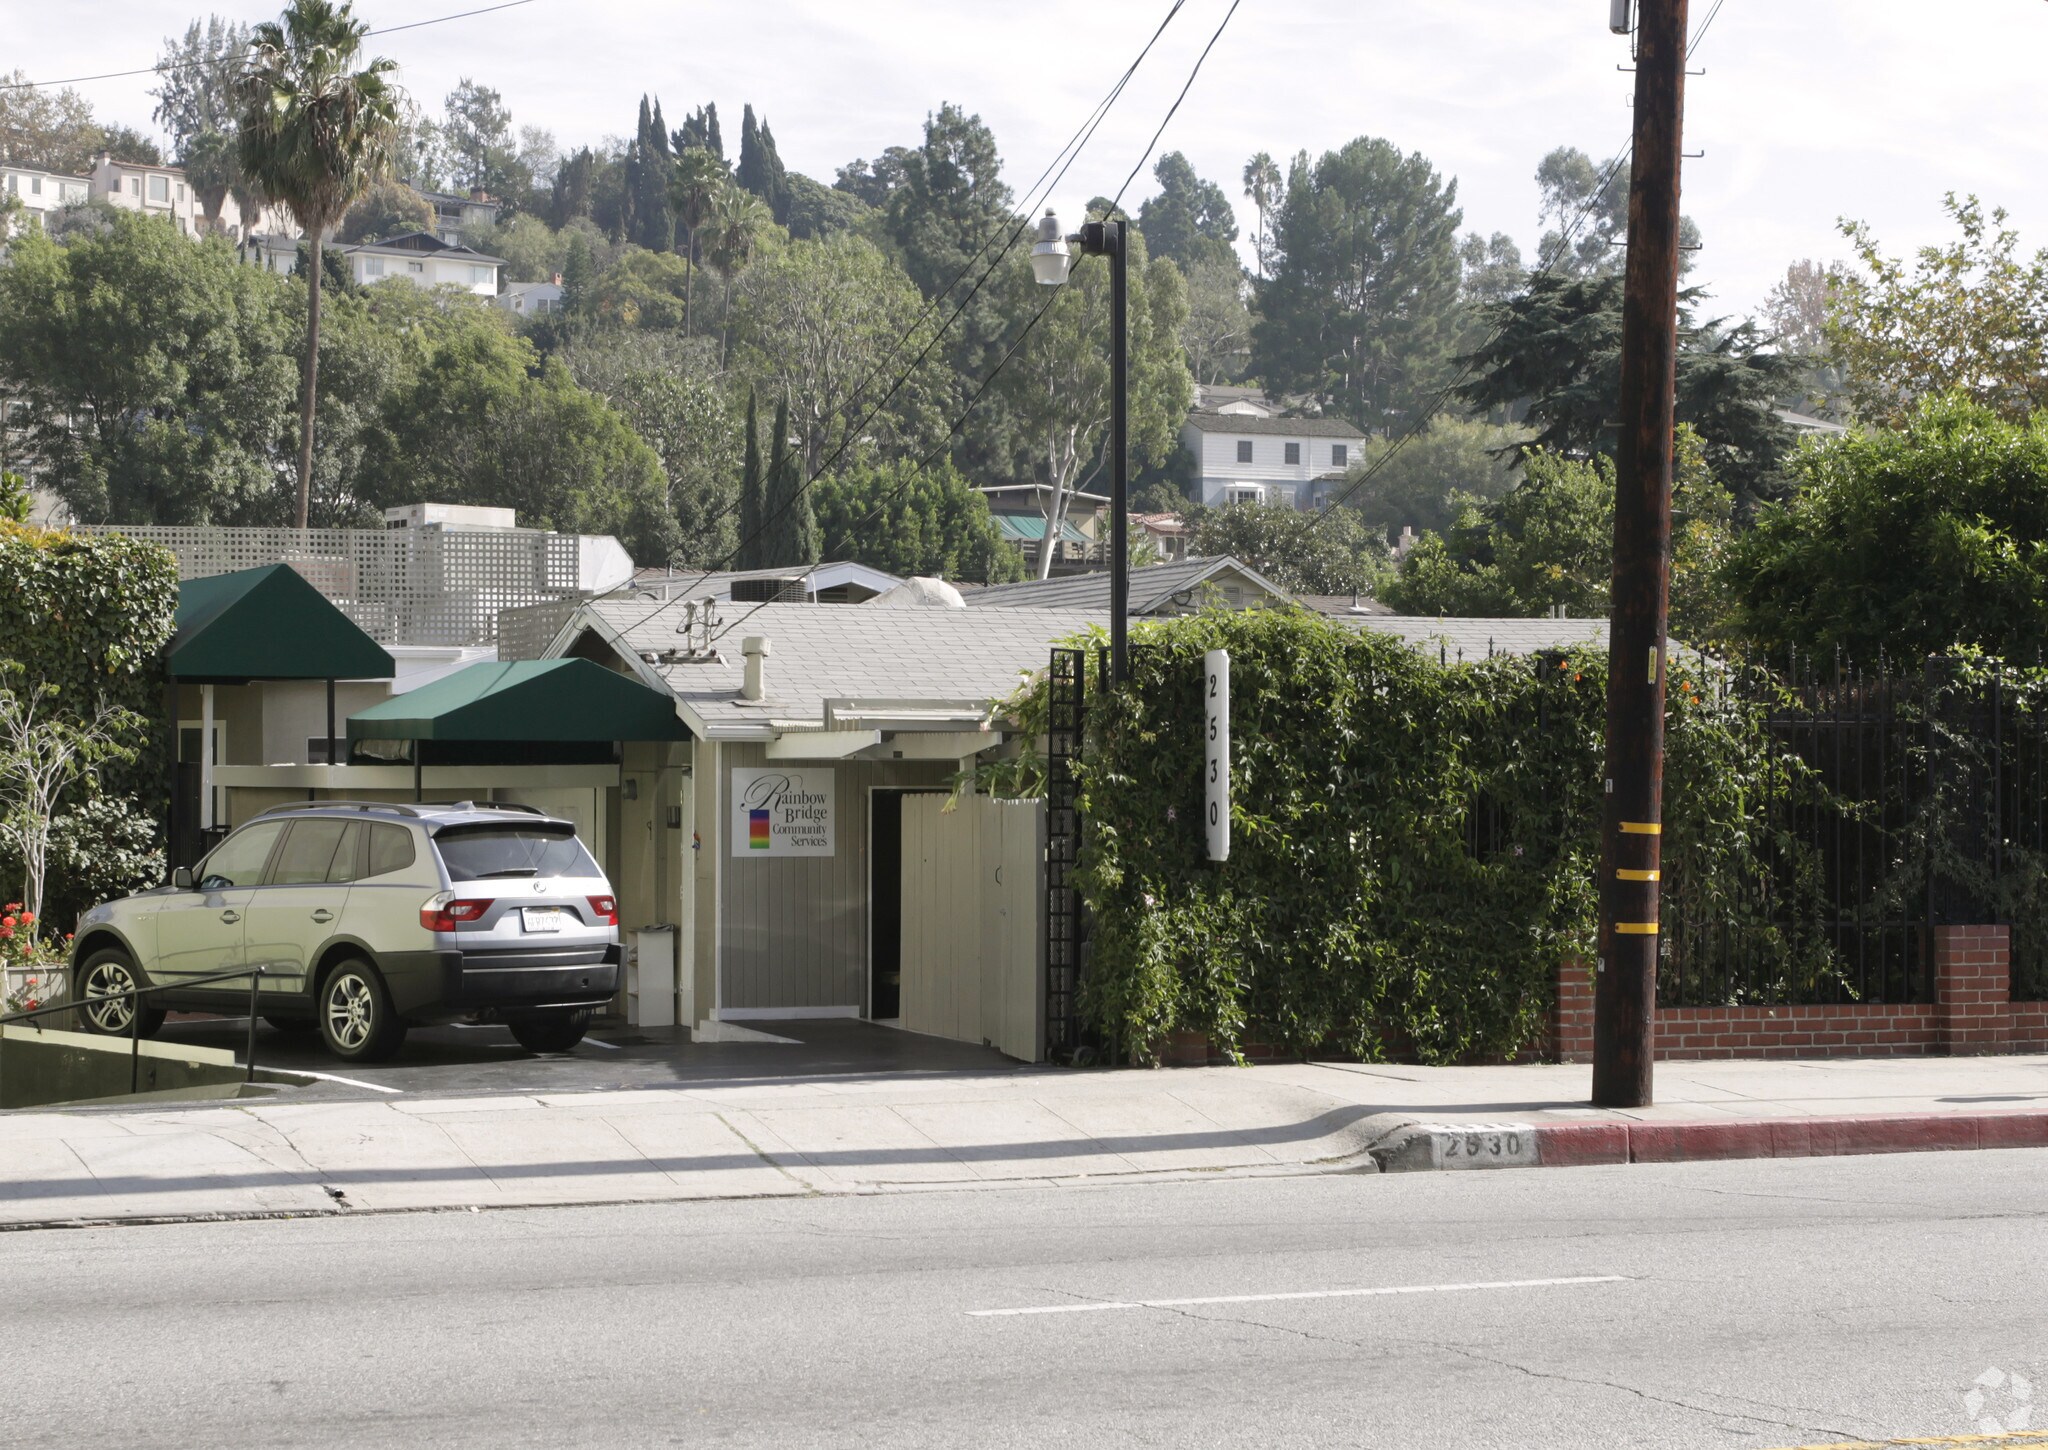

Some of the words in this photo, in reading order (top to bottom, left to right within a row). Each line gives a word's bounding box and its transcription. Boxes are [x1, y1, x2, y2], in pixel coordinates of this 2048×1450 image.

[1209, 674, 1218, 827] 2530
[740, 774, 827, 813] Rainbow
[785, 805, 828, 824] Bridge
[772, 823, 827, 836] Community
[791, 835, 828, 846] Services
[1445, 1133, 1520, 1156] 2530
